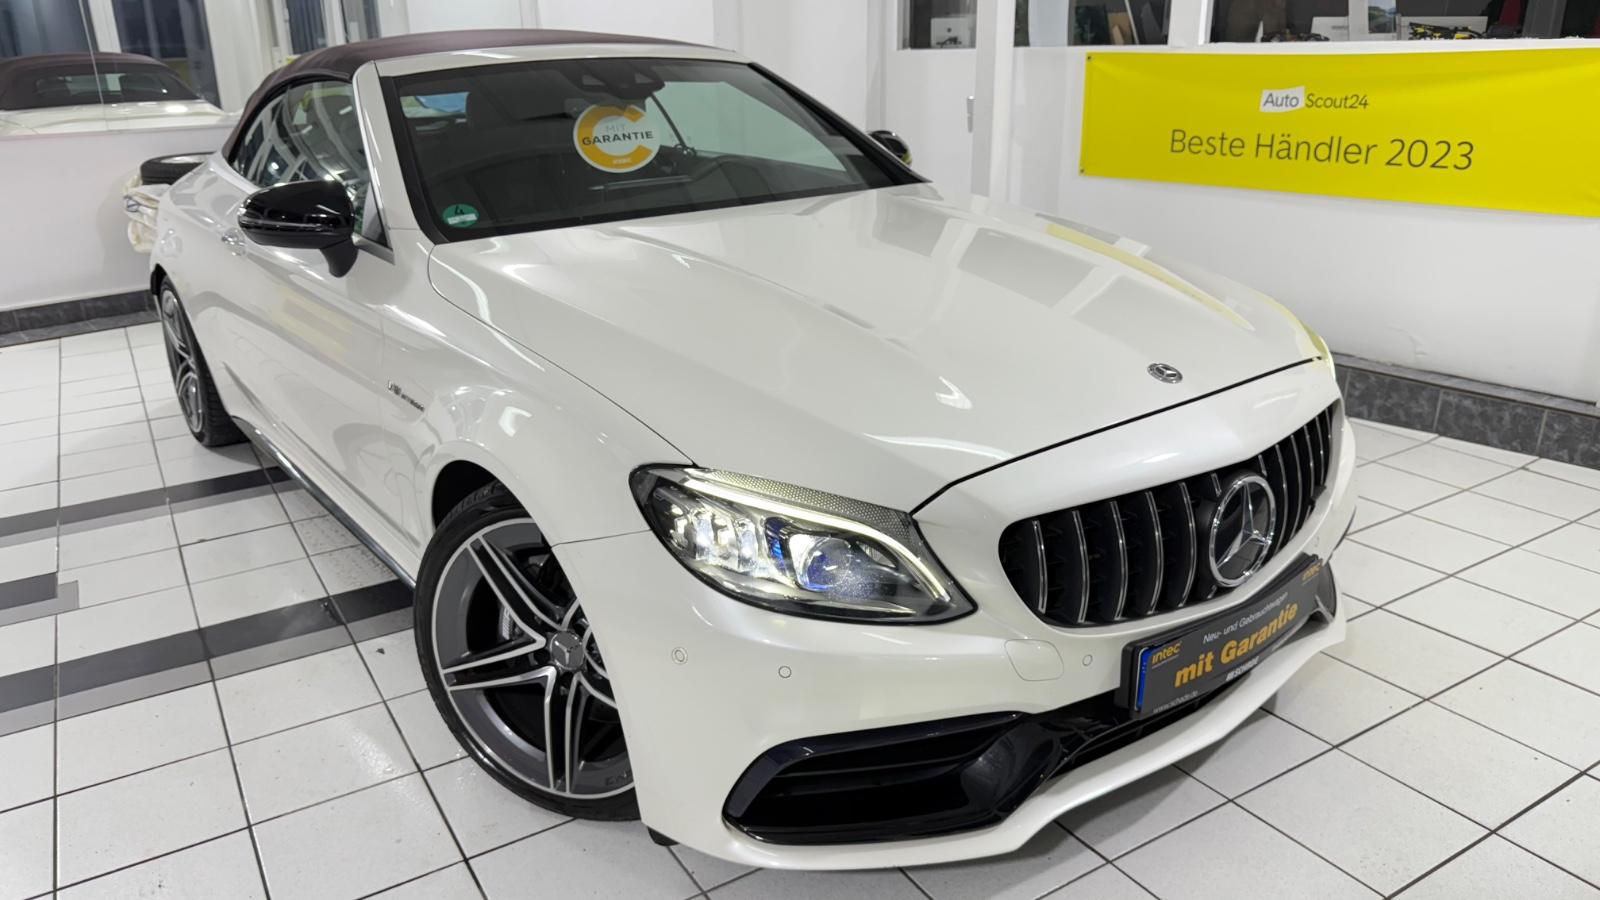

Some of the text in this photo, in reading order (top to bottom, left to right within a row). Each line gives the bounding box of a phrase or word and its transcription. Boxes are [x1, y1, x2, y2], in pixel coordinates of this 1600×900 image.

[1263, 91, 1369, 110] Auto Scout24
[582, 130, 654, 146] GARANTIE
[1170, 129, 1474, 171] Beste Händler 2023
[1151, 642, 1181, 665] intec
[1174, 652, 1214, 688] mit
[1220, 602, 1299, 664] Garantie
